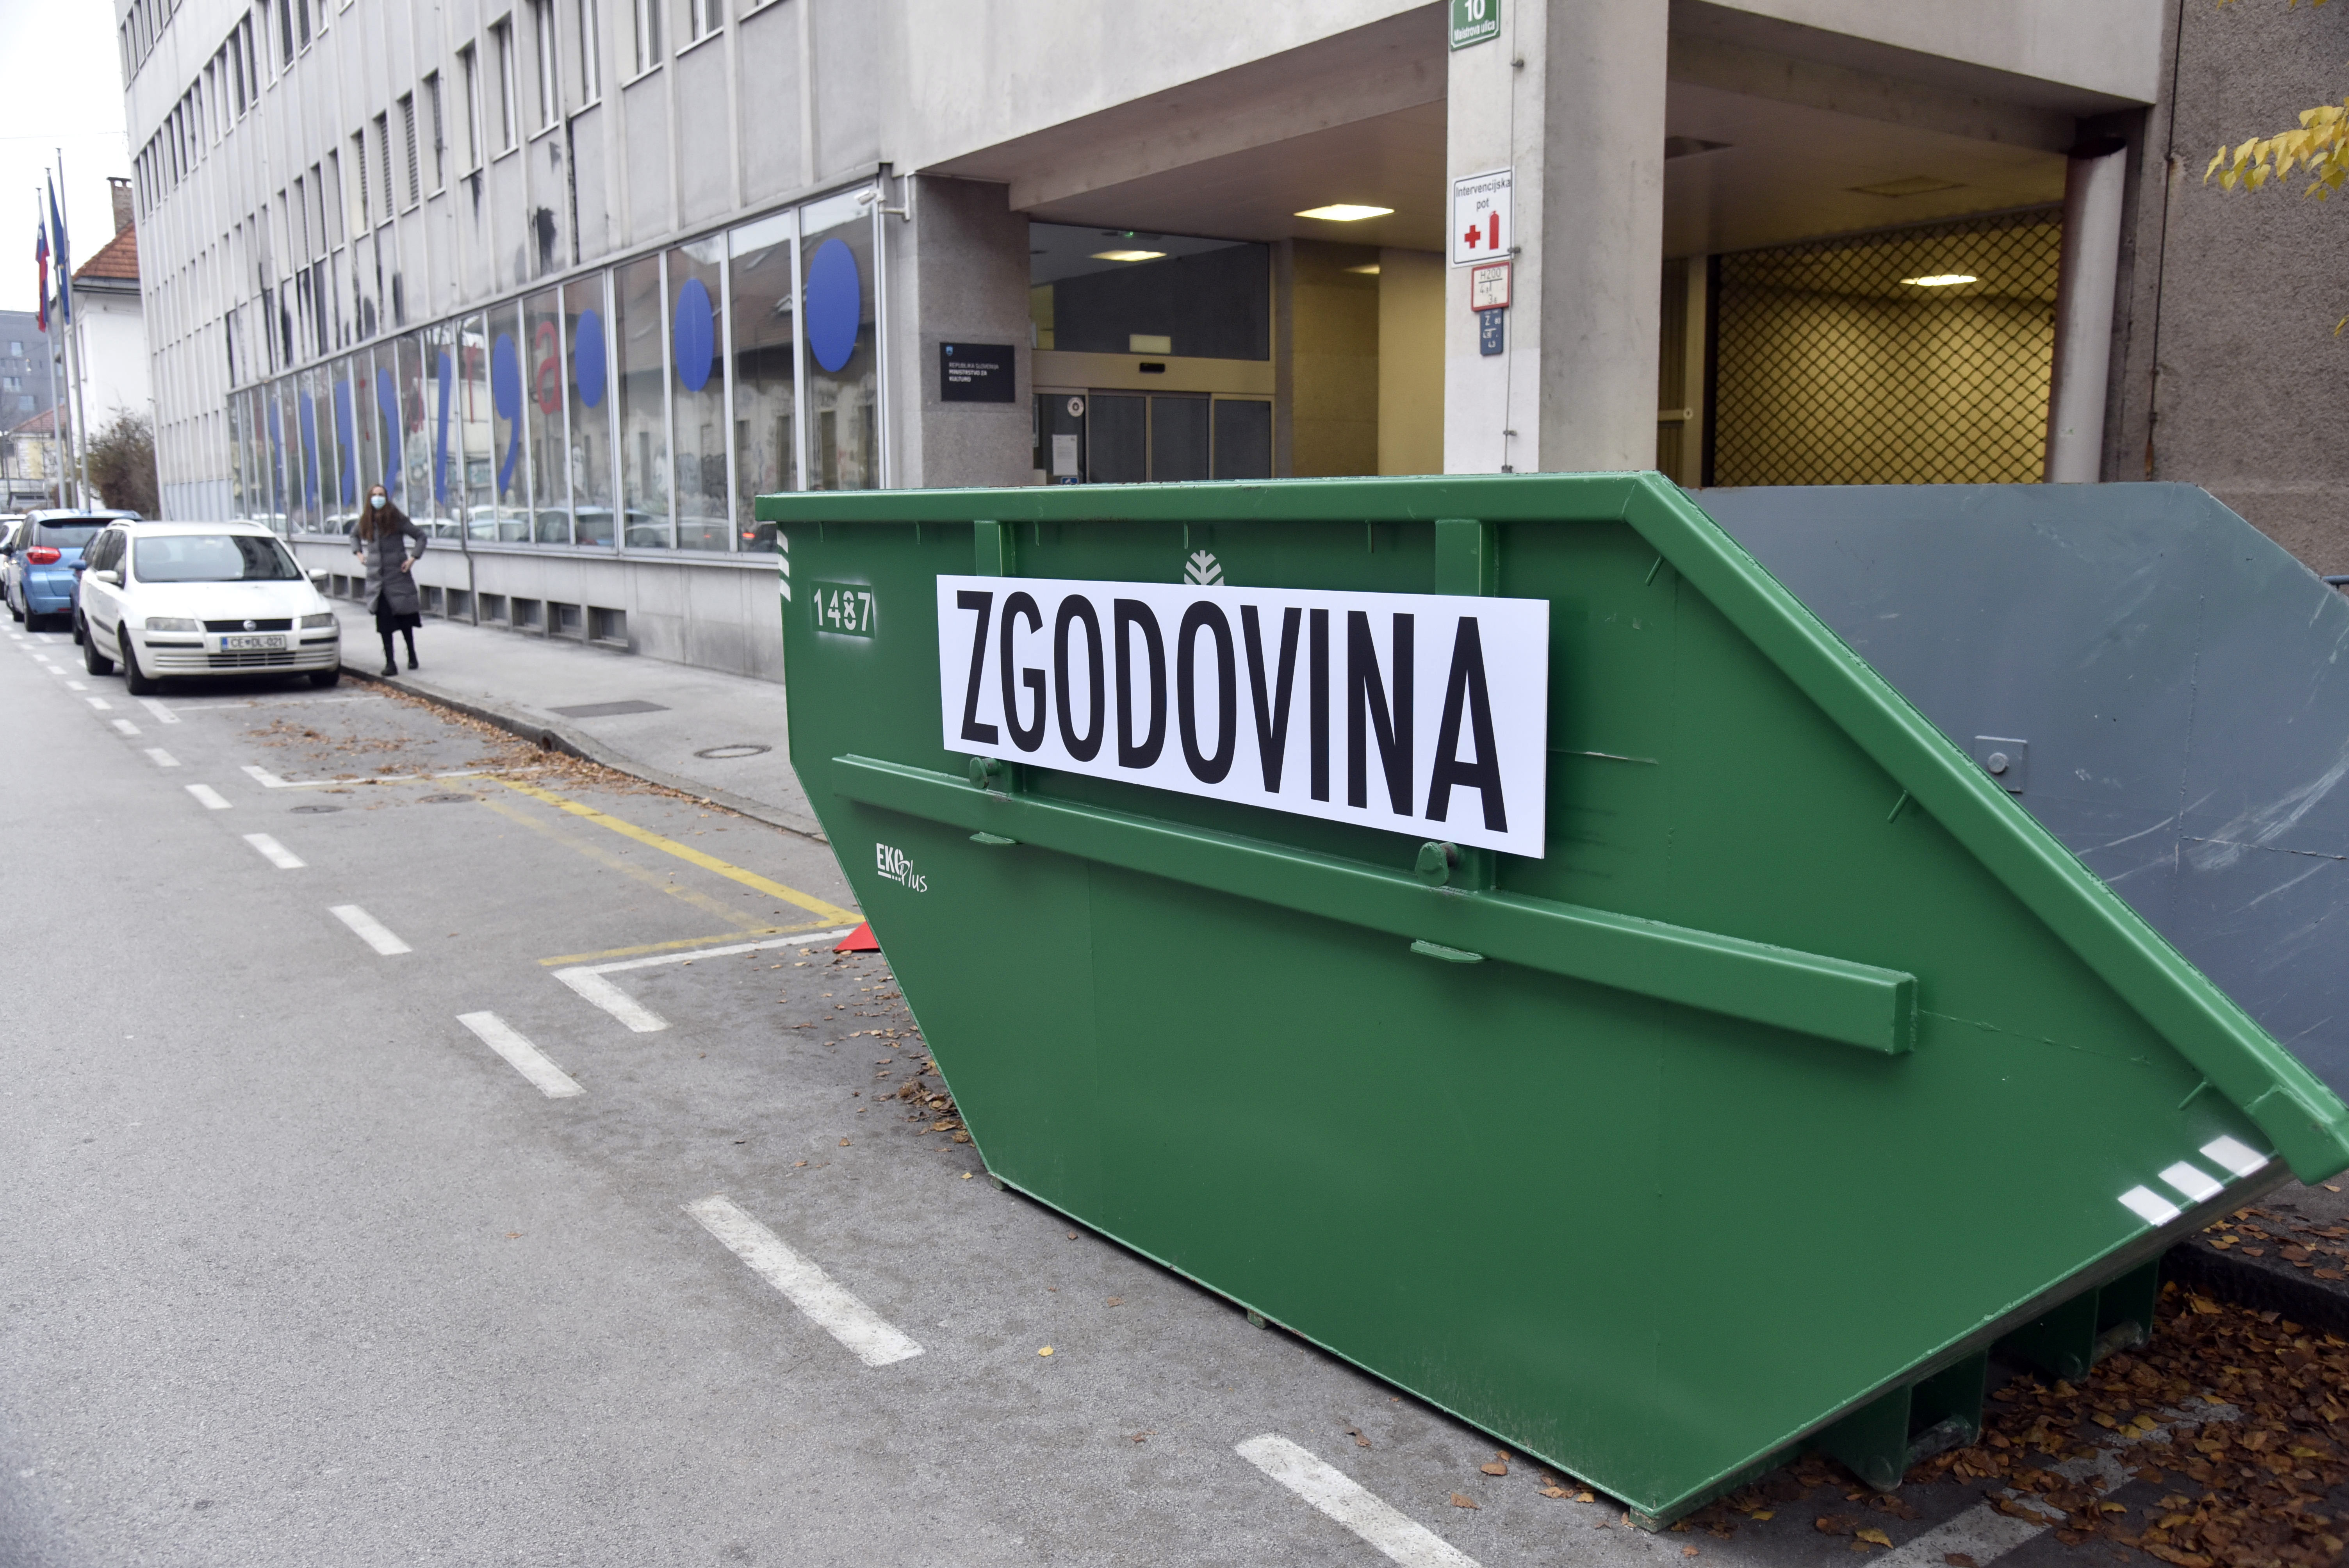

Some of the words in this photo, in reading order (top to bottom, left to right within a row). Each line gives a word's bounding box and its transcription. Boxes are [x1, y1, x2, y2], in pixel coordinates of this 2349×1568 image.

[1464, 0, 1485, 22] 10
[1481, 19, 1495, 33] ulica
[1456, 178, 1511, 197] Intervencijska
[1476, 198, 1489, 212] pot
[814, 588, 871, 631] 1487
[957, 590, 1508, 833] ZGODOVINA
